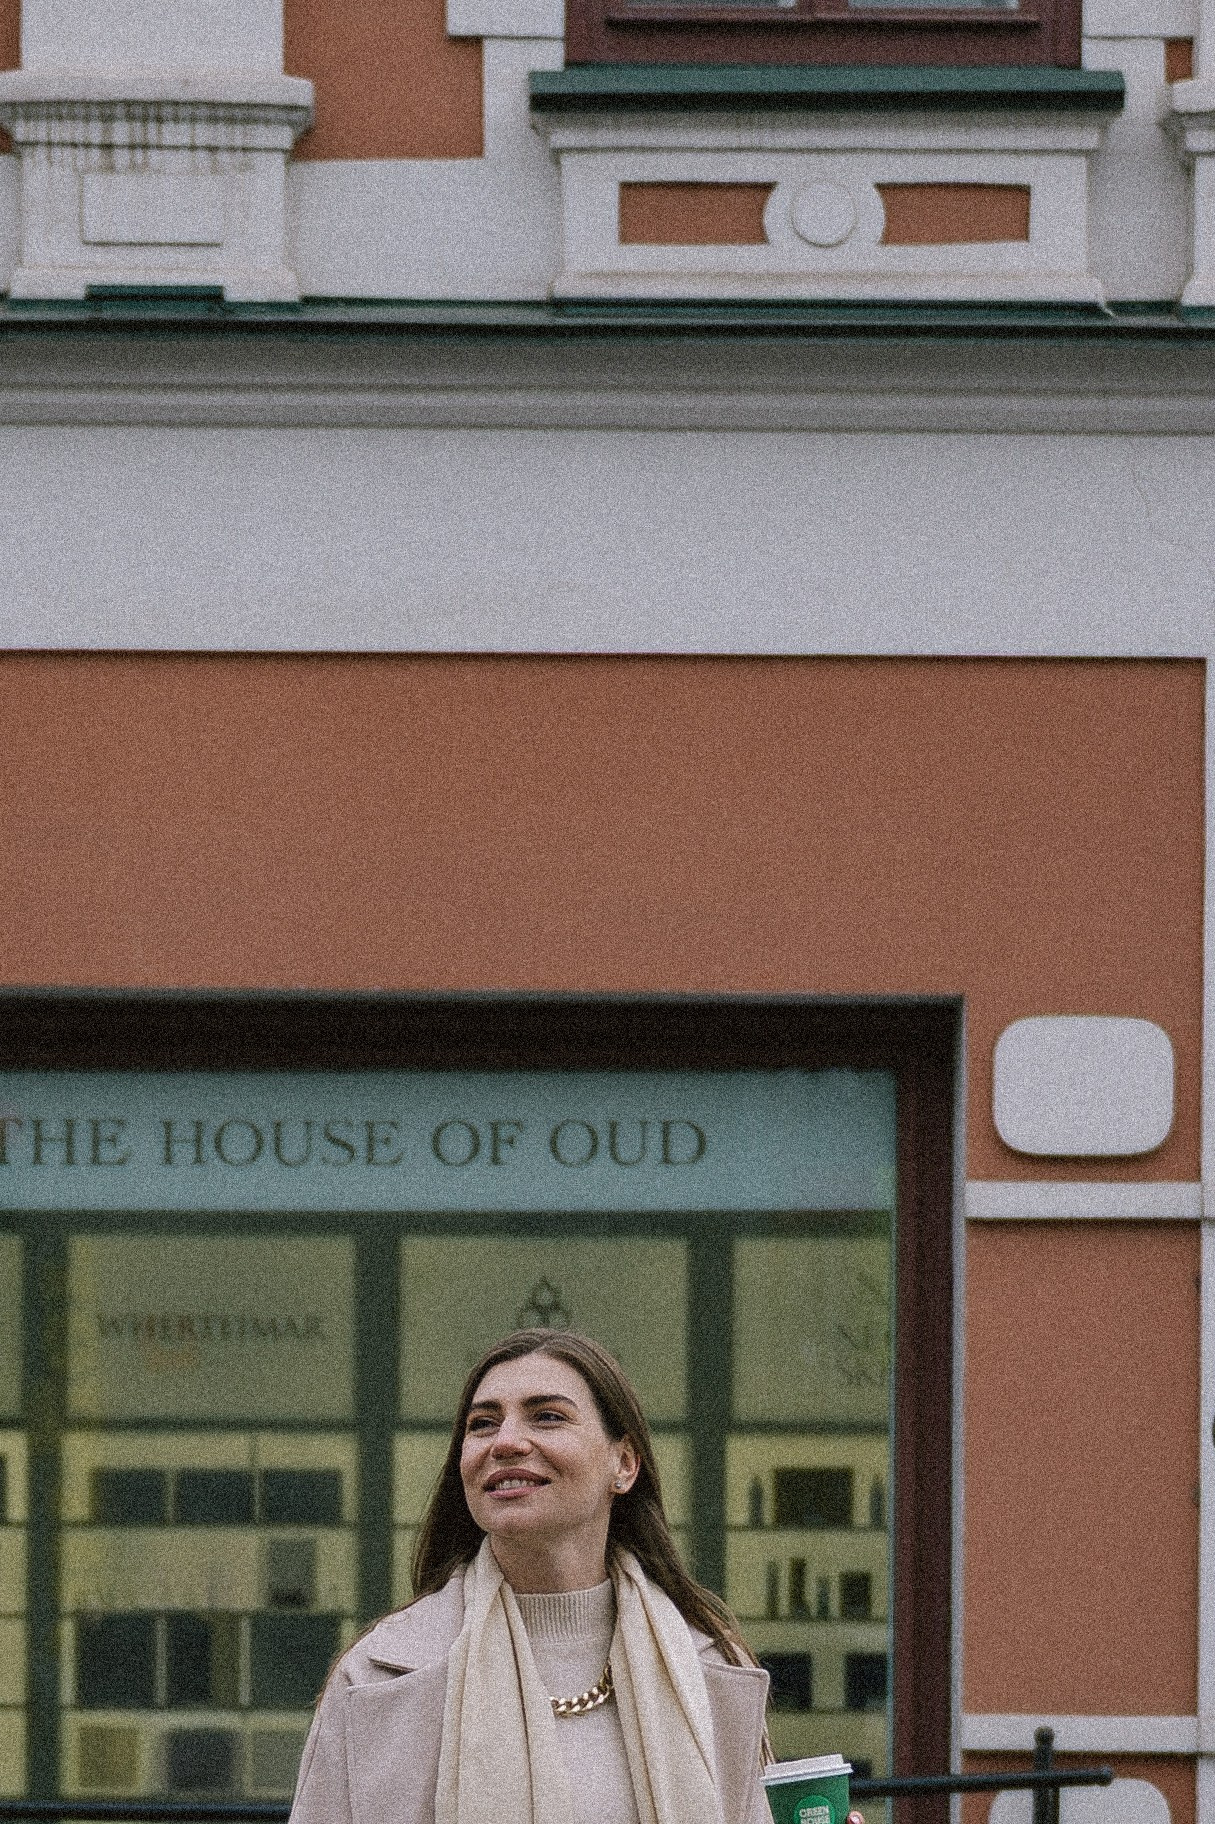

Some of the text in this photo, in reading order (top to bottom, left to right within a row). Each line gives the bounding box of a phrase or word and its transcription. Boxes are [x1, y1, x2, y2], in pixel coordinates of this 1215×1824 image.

[162, 1119, 401, 1167] HOUSE
[429, 1119, 523, 1167] OF
[549, 1119, 707, 1167] OUD
